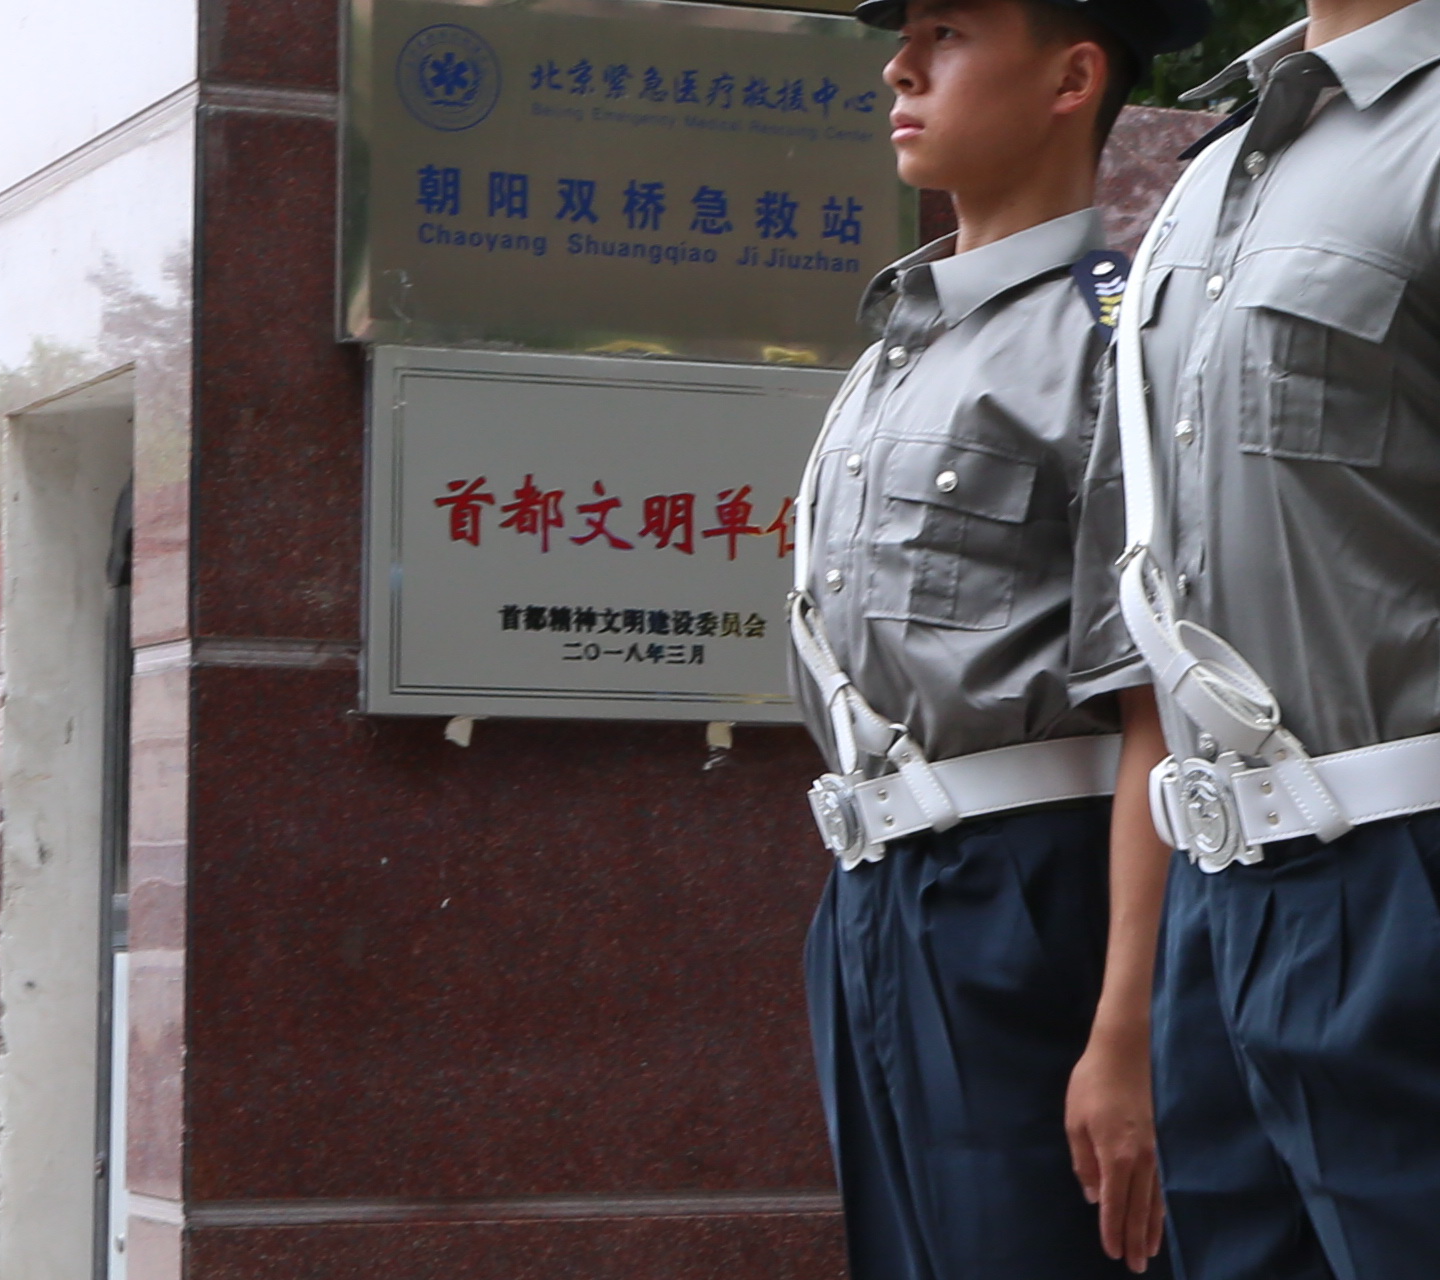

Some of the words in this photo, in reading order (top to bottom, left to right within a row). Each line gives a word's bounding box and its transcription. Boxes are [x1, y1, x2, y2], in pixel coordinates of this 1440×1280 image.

[529, 58, 877, 119] 北京紧急医疗救援中心
[416, 164, 864, 245] 朝阳双桥急救站
[418, 222, 547, 257] Chaoyang
[567, 232, 717, 265] Shuangqiao
[499, 604, 766, 639] 首都精神文明建设委员会
